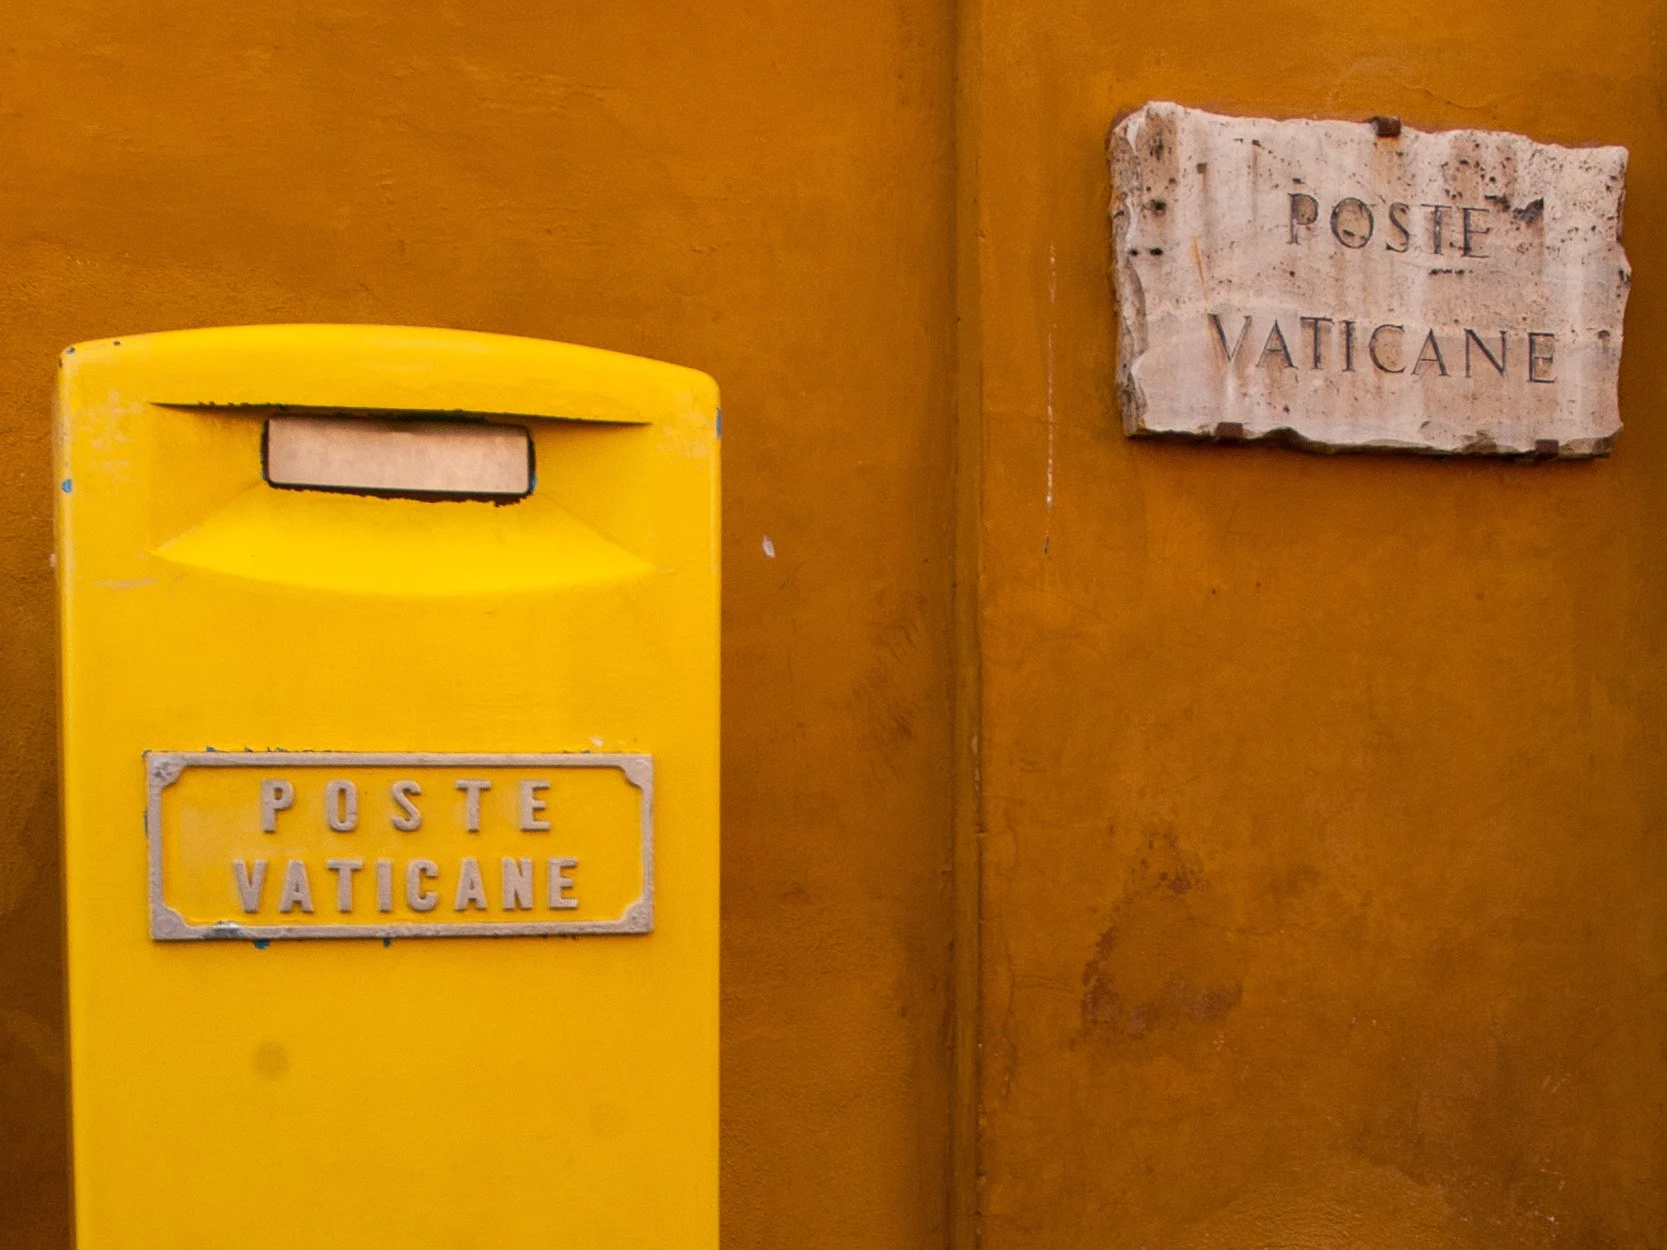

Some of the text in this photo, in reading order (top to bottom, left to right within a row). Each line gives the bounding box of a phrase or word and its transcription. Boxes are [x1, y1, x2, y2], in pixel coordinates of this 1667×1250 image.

[1286, 192, 1490, 259] POSTE
[1207, 314, 1557, 383] VATICANE
[260, 780, 551, 832] POSTE
[234, 857, 579, 914] VATICANE
